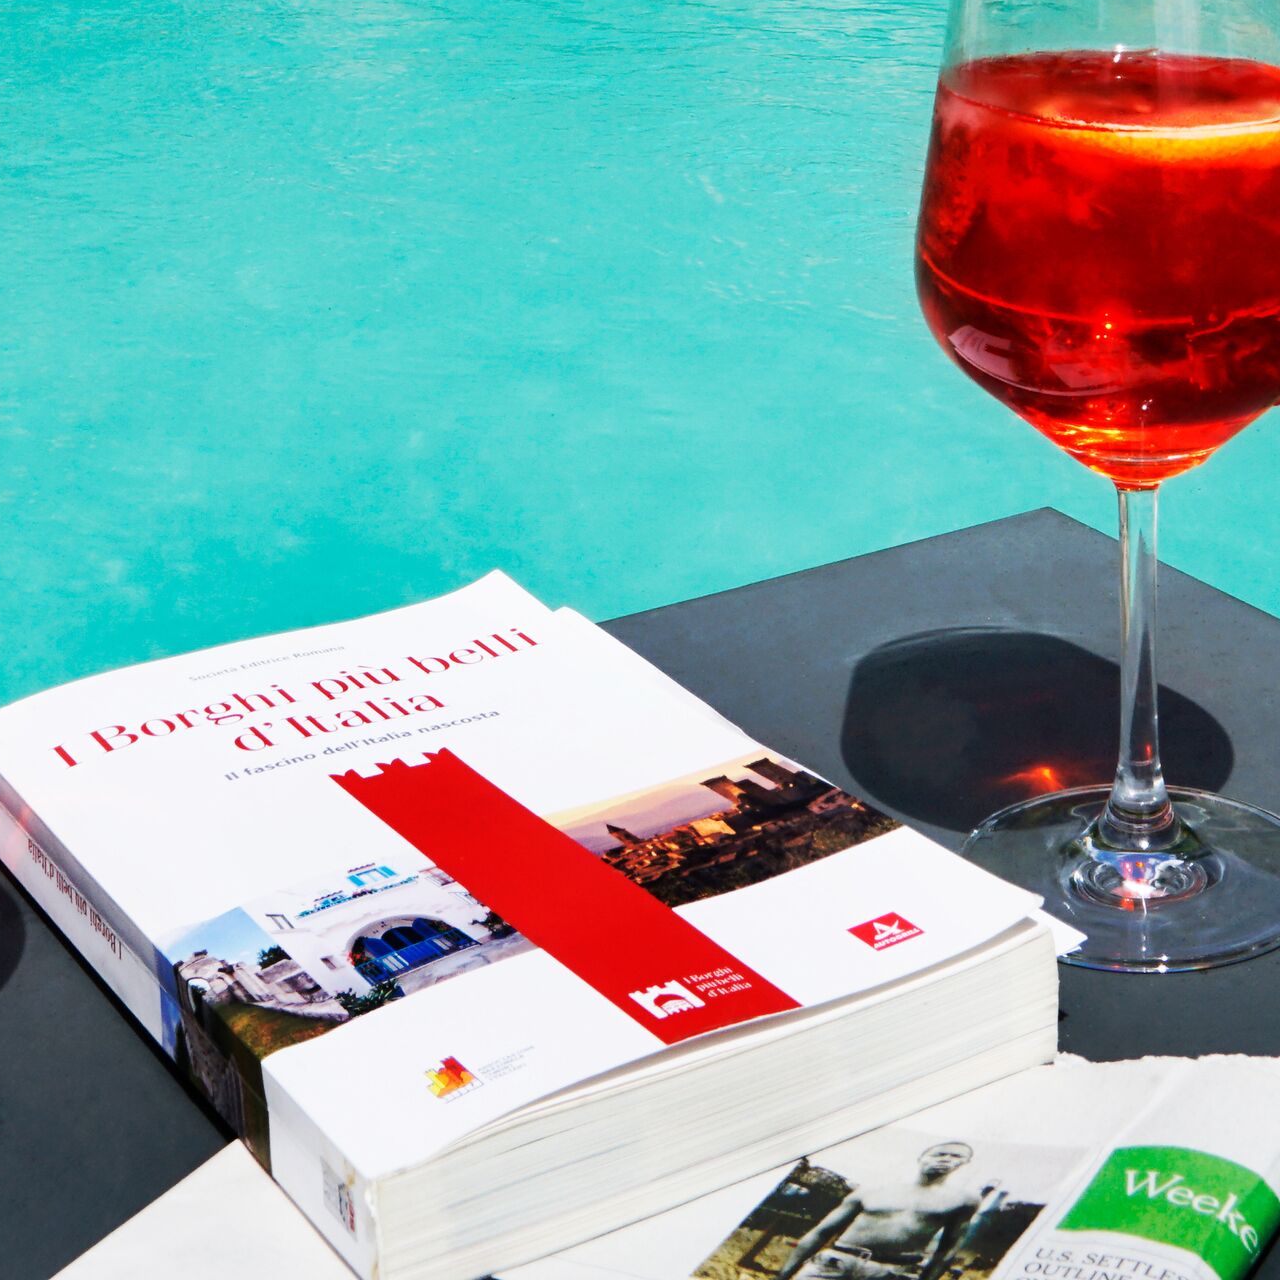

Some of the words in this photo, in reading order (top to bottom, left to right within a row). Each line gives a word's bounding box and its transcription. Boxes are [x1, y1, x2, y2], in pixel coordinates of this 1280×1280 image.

[293, 645, 345, 659] Romana
[47, 742, 83, 769] I
[86, 684, 301, 753] Borghi
[307, 665, 405, 701] più
[403, 628, 543, 675] belli
[224, 771, 239, 781] Il
[244, 752, 317, 776] fascino
[417, 710, 500, 734] nascosta
[56, 872, 73, 904] belli
[89, 909, 117, 953] Borghi
[1125, 1169, 1260, 1260] Weeke
[1035, 1247, 1074, 1262] U.S.
